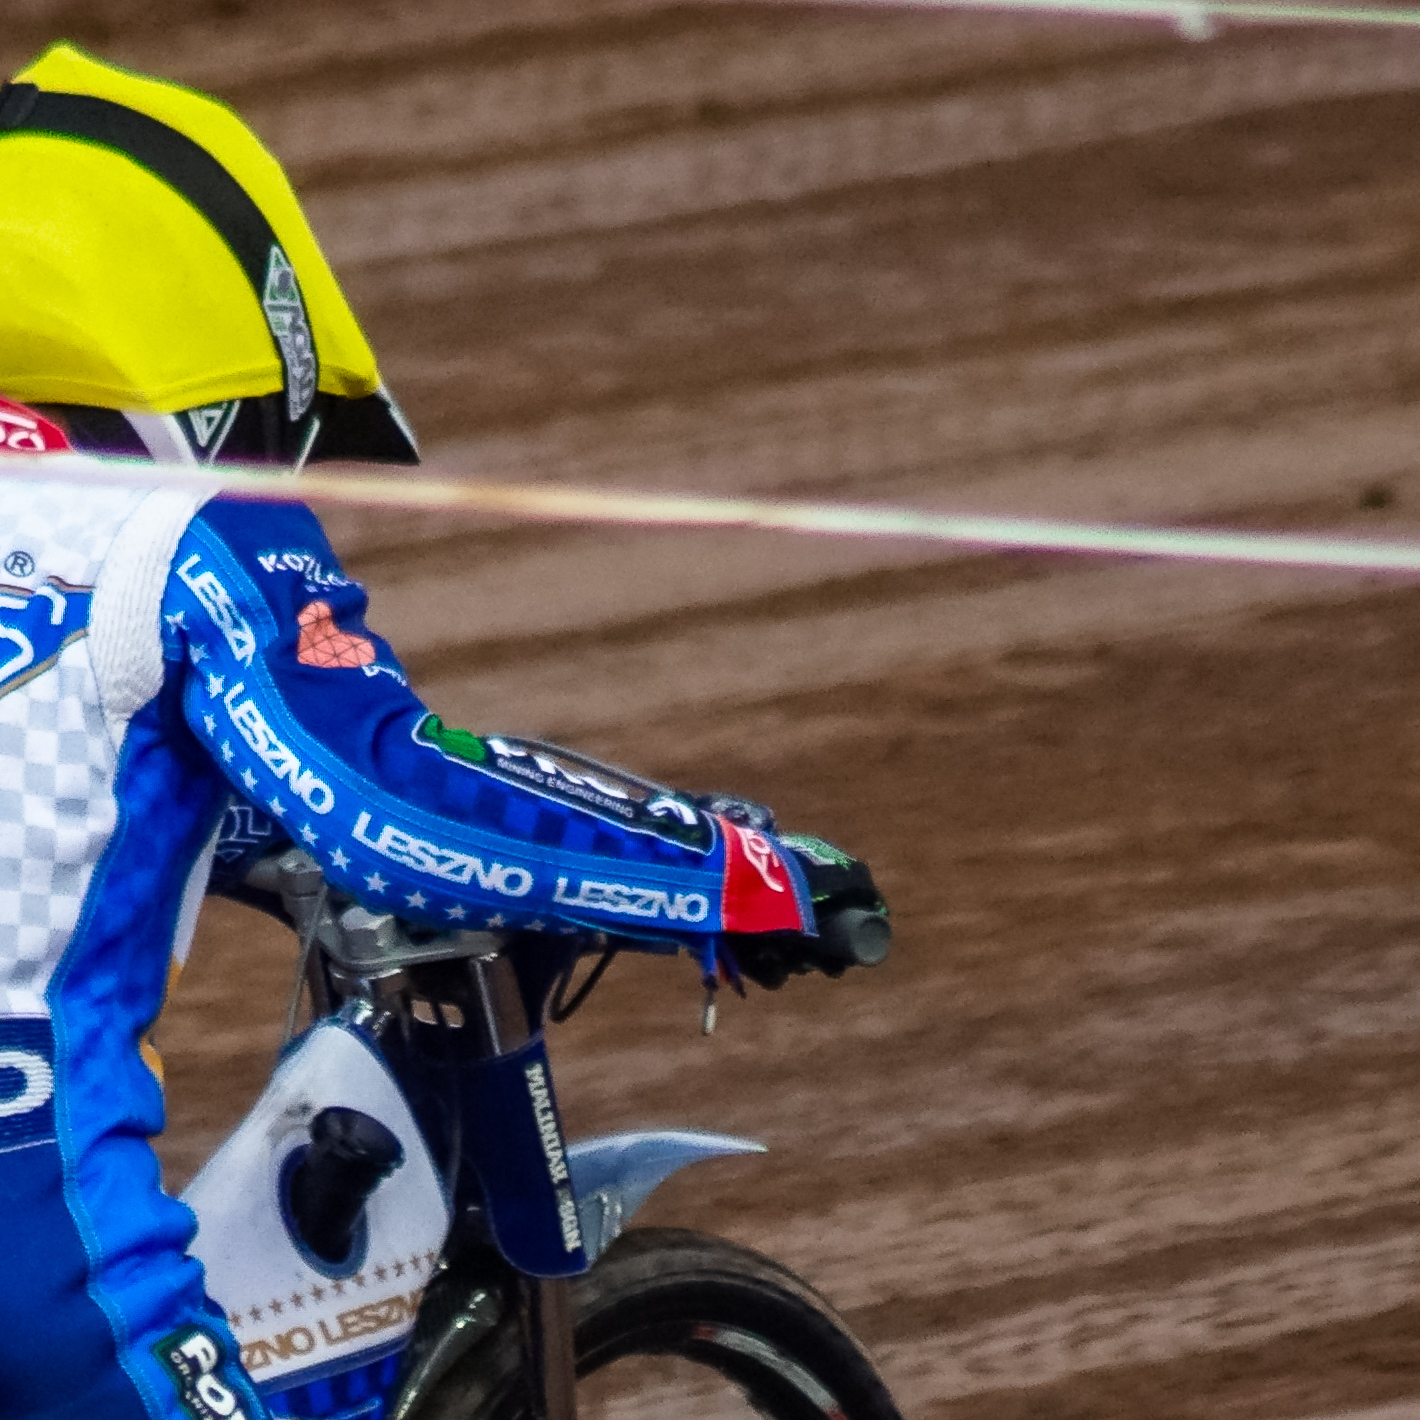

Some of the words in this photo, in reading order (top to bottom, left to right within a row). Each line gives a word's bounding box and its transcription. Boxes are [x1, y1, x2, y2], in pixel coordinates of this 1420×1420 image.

[223, 681, 335, 815] LESZNO
[352, 811, 532, 898] LESZNO
[554, 874, 709, 924] LESZNO
